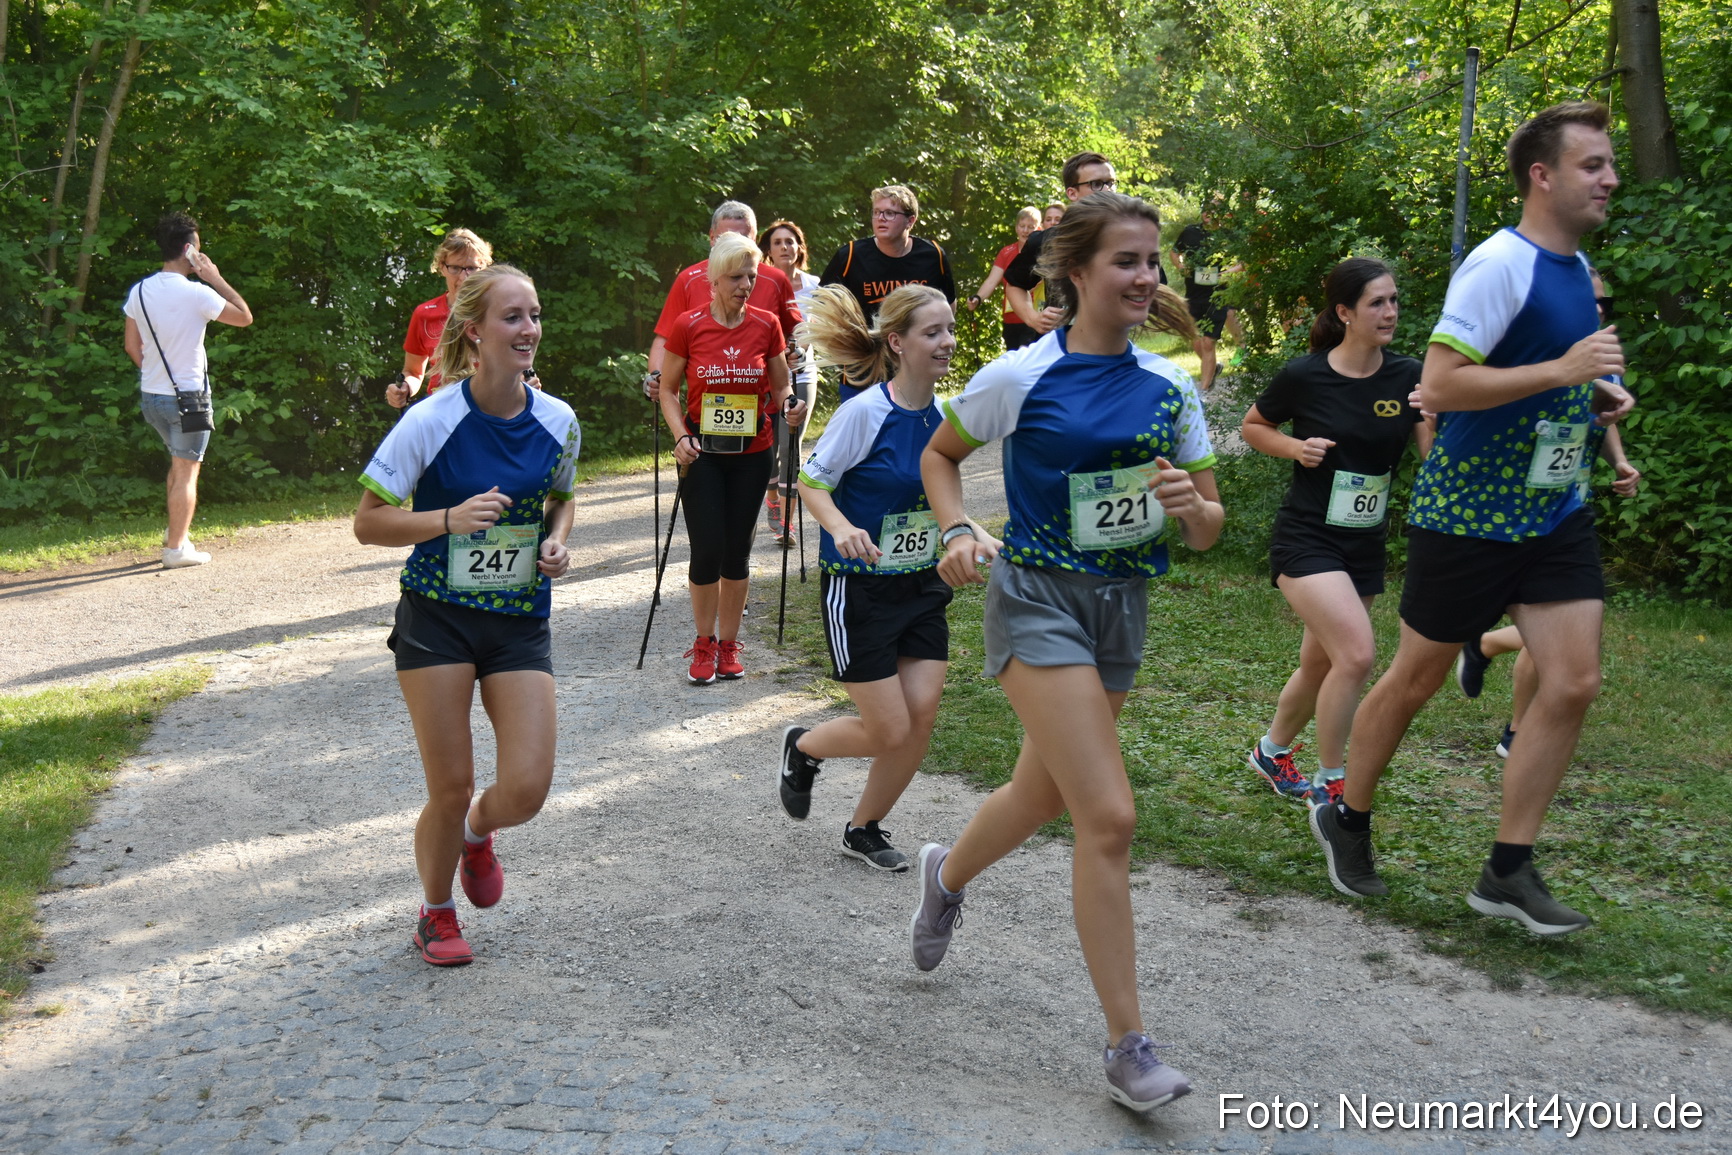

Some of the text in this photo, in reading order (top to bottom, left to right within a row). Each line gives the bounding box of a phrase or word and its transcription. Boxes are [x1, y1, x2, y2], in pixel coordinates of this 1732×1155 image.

[863, 282, 872, 296] BIT
[696, 364, 725, 378] Echtes
[713, 409, 744, 424] 593
[1547, 446, 1582, 470] 257
[1095, 493, 1147, 528] 221
[1354, 494, 1377, 513] 60
[1099, 521, 1151, 537] Hensl Hannah
[892, 531, 928, 554] 265
[468, 549, 520, 573] 247
